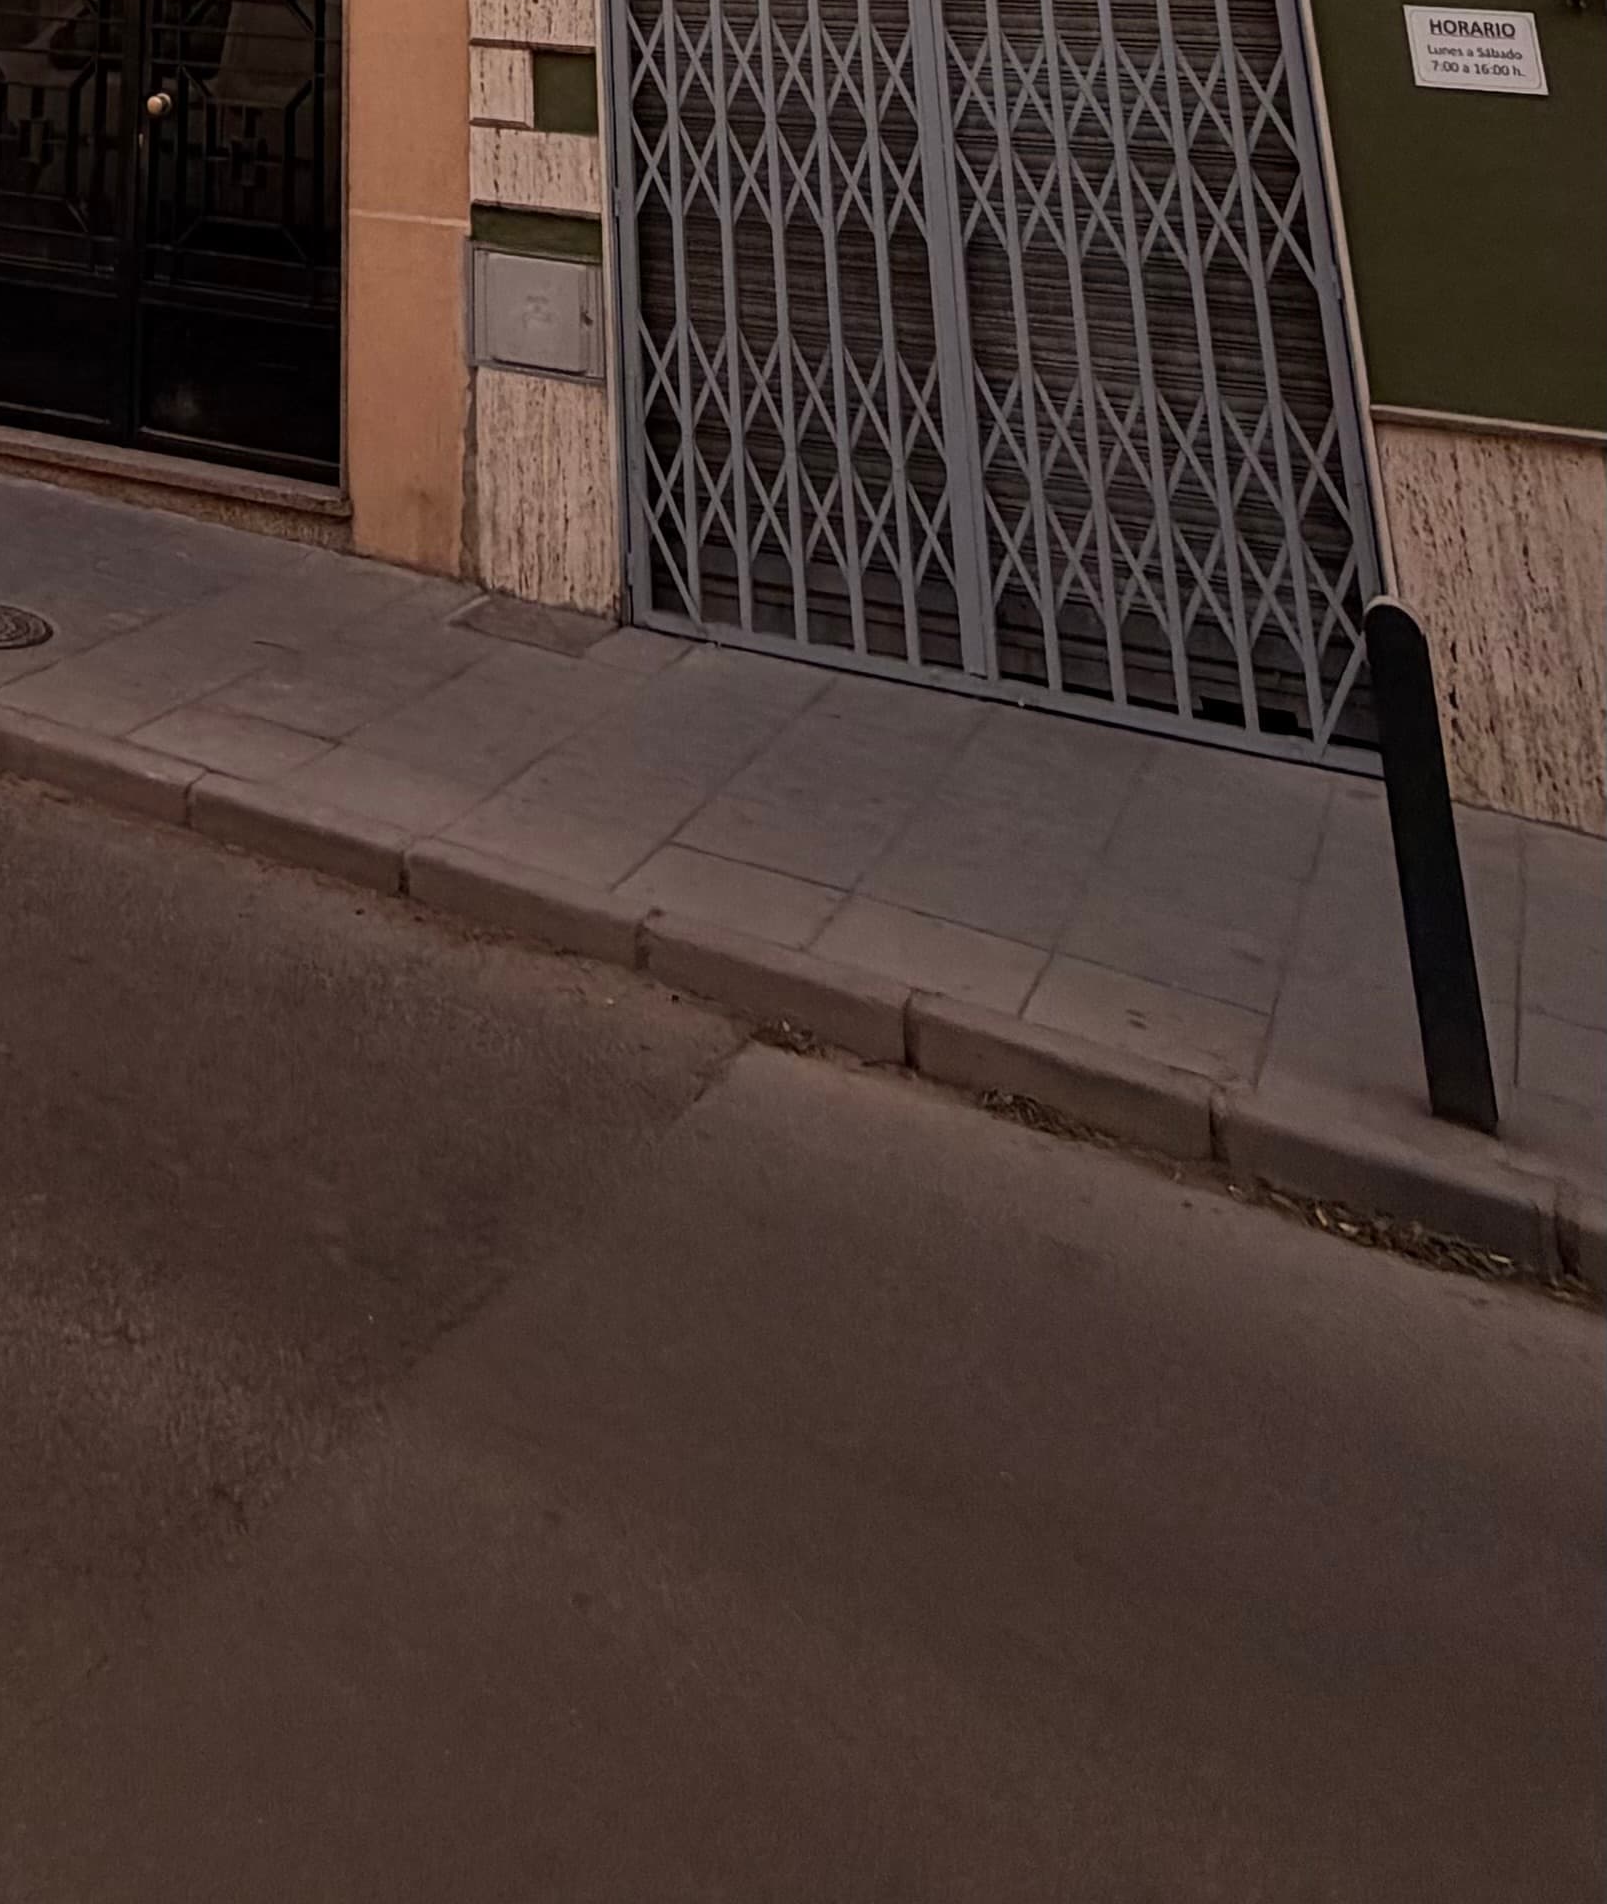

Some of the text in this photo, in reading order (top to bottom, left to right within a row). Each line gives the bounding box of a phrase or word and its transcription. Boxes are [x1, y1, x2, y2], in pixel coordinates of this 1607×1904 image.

[1429, 19, 1516, 38] HORARIO
[1427, 44, 1464, 57] Lunes
[1467, 48, 1474, 57] a
[1462, 64, 1470, 73] a
